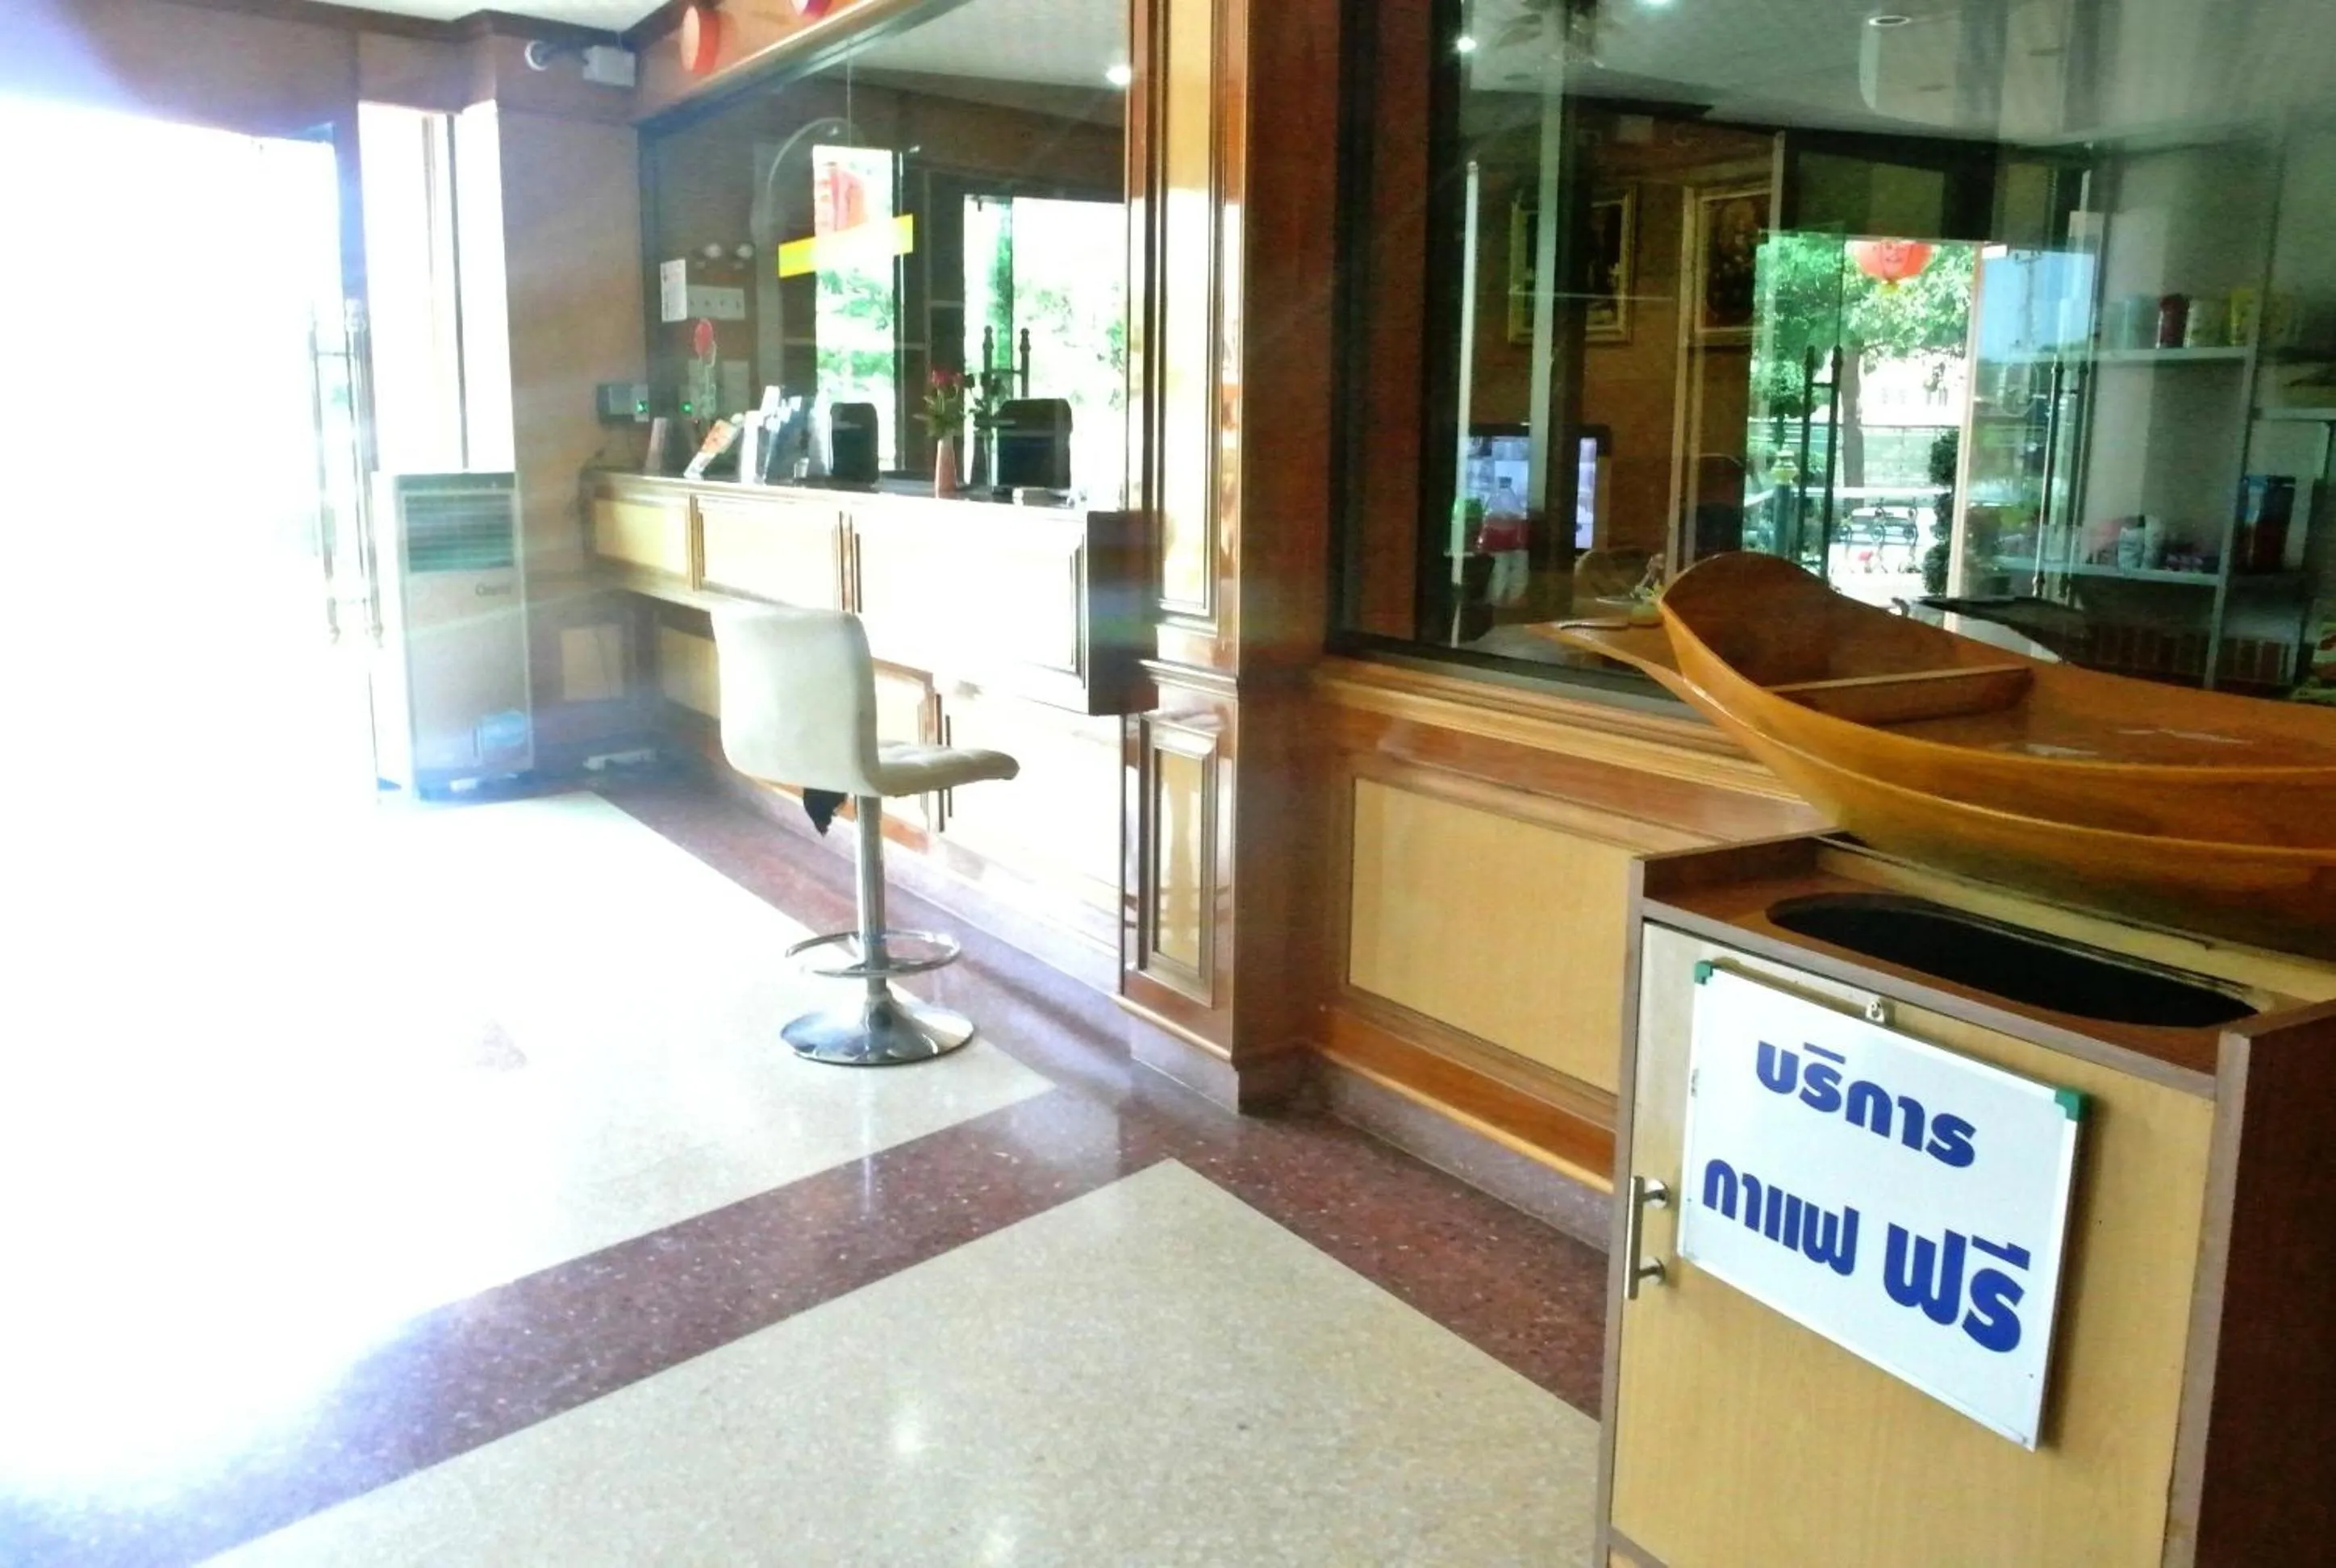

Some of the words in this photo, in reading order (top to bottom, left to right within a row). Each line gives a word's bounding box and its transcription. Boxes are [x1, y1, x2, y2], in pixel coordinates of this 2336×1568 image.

[1756, 1040, 1977, 1169] บริการ
[1701, 1158, 1860, 1277] กาแฟ
[1883, 1222, 2031, 1353] ฟรี
